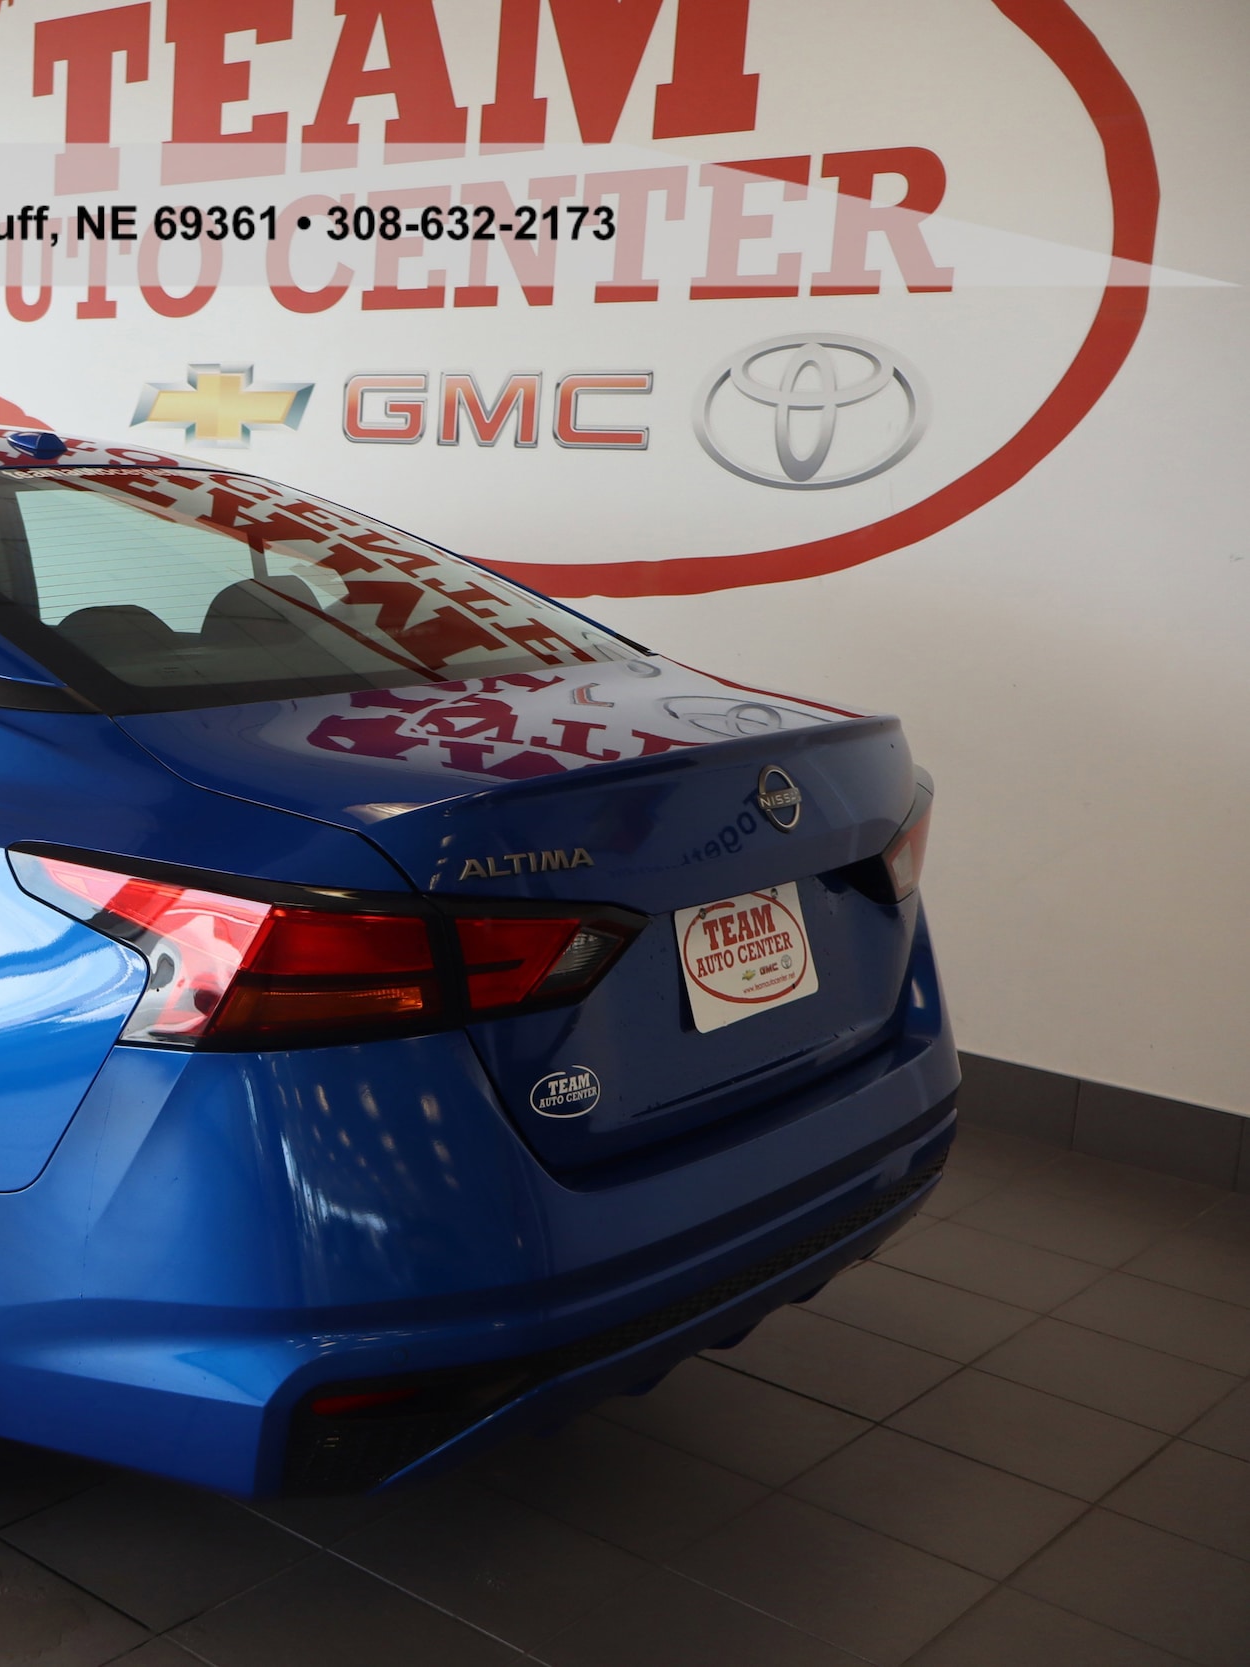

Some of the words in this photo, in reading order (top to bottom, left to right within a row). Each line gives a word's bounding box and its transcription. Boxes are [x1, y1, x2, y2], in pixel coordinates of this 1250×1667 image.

[32, 0, 760, 196] TEAM
[264, 145, 955, 314] CENTER
[342, 369, 655, 450] GMC
[458, 847, 595, 881] ALTIMA
[702, 903, 776, 951] TEAM
[695, 949, 735, 978] AUTO
[737, 931, 794, 964] CENTER
[759, 962, 780, 976] GMC
[538, 1095, 564, 1109] AUTO
[565, 1086, 598, 1103] CENTER
[547, 1072, 591, 1096] TEAM
